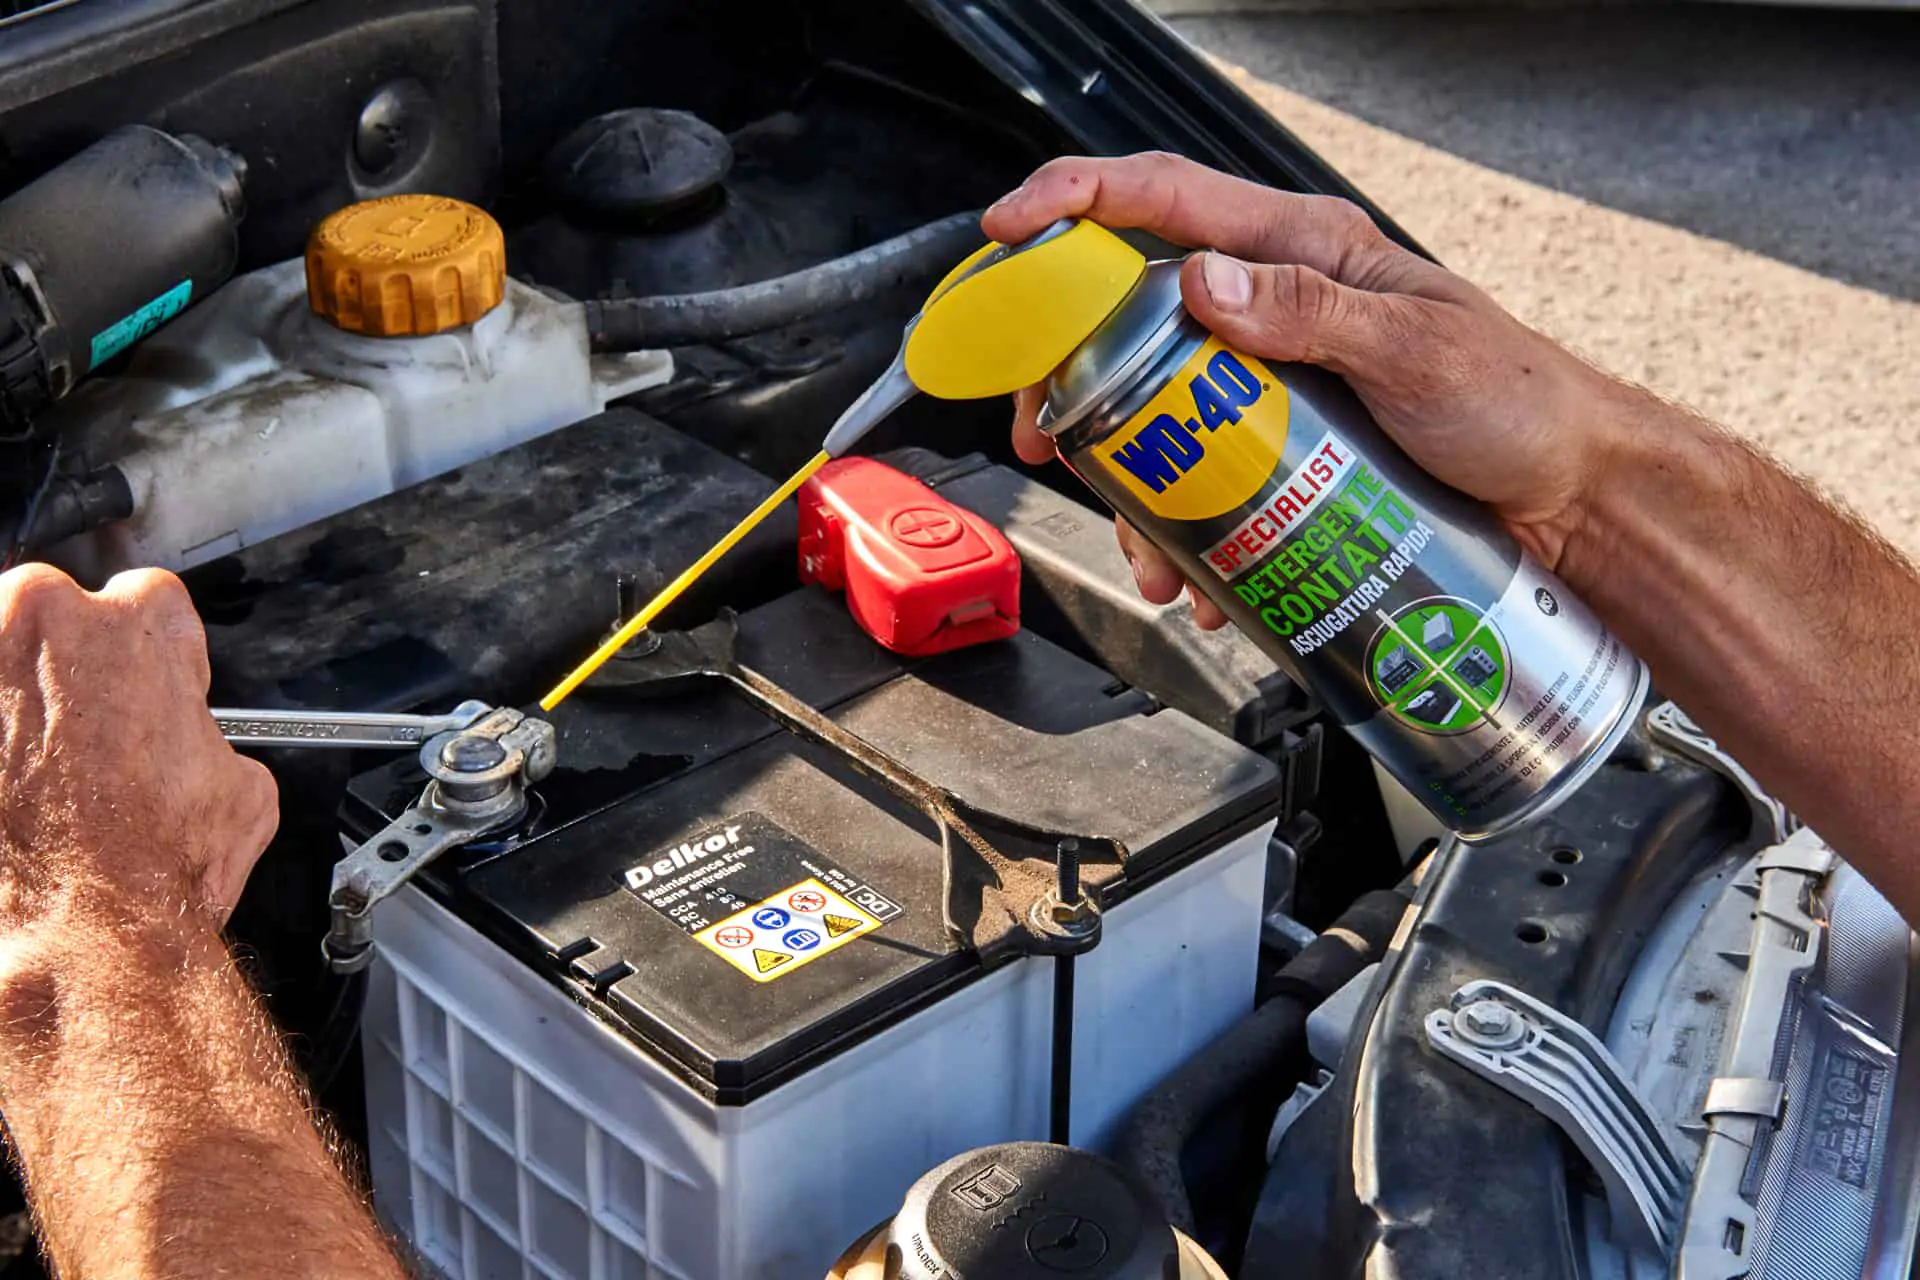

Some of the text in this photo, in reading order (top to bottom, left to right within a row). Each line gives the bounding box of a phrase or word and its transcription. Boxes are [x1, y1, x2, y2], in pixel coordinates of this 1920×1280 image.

[1209, 442, 1344, 574] SPECIALIST
[1234, 464, 1384, 607] DETERGENTE
[1260, 489, 1416, 636] CONTATTI
[1289, 520, 1435, 657] ASCIUGATURA RAPIDA
[625, 825, 741, 889] Delkor
[642, 846, 755, 900] Maintenance Free
[653, 861, 747, 908] Sans entretien
[669, 901, 698, 917] CCA
[690, 917, 710, 931] AH
[857, 893, 890, 913] DC
